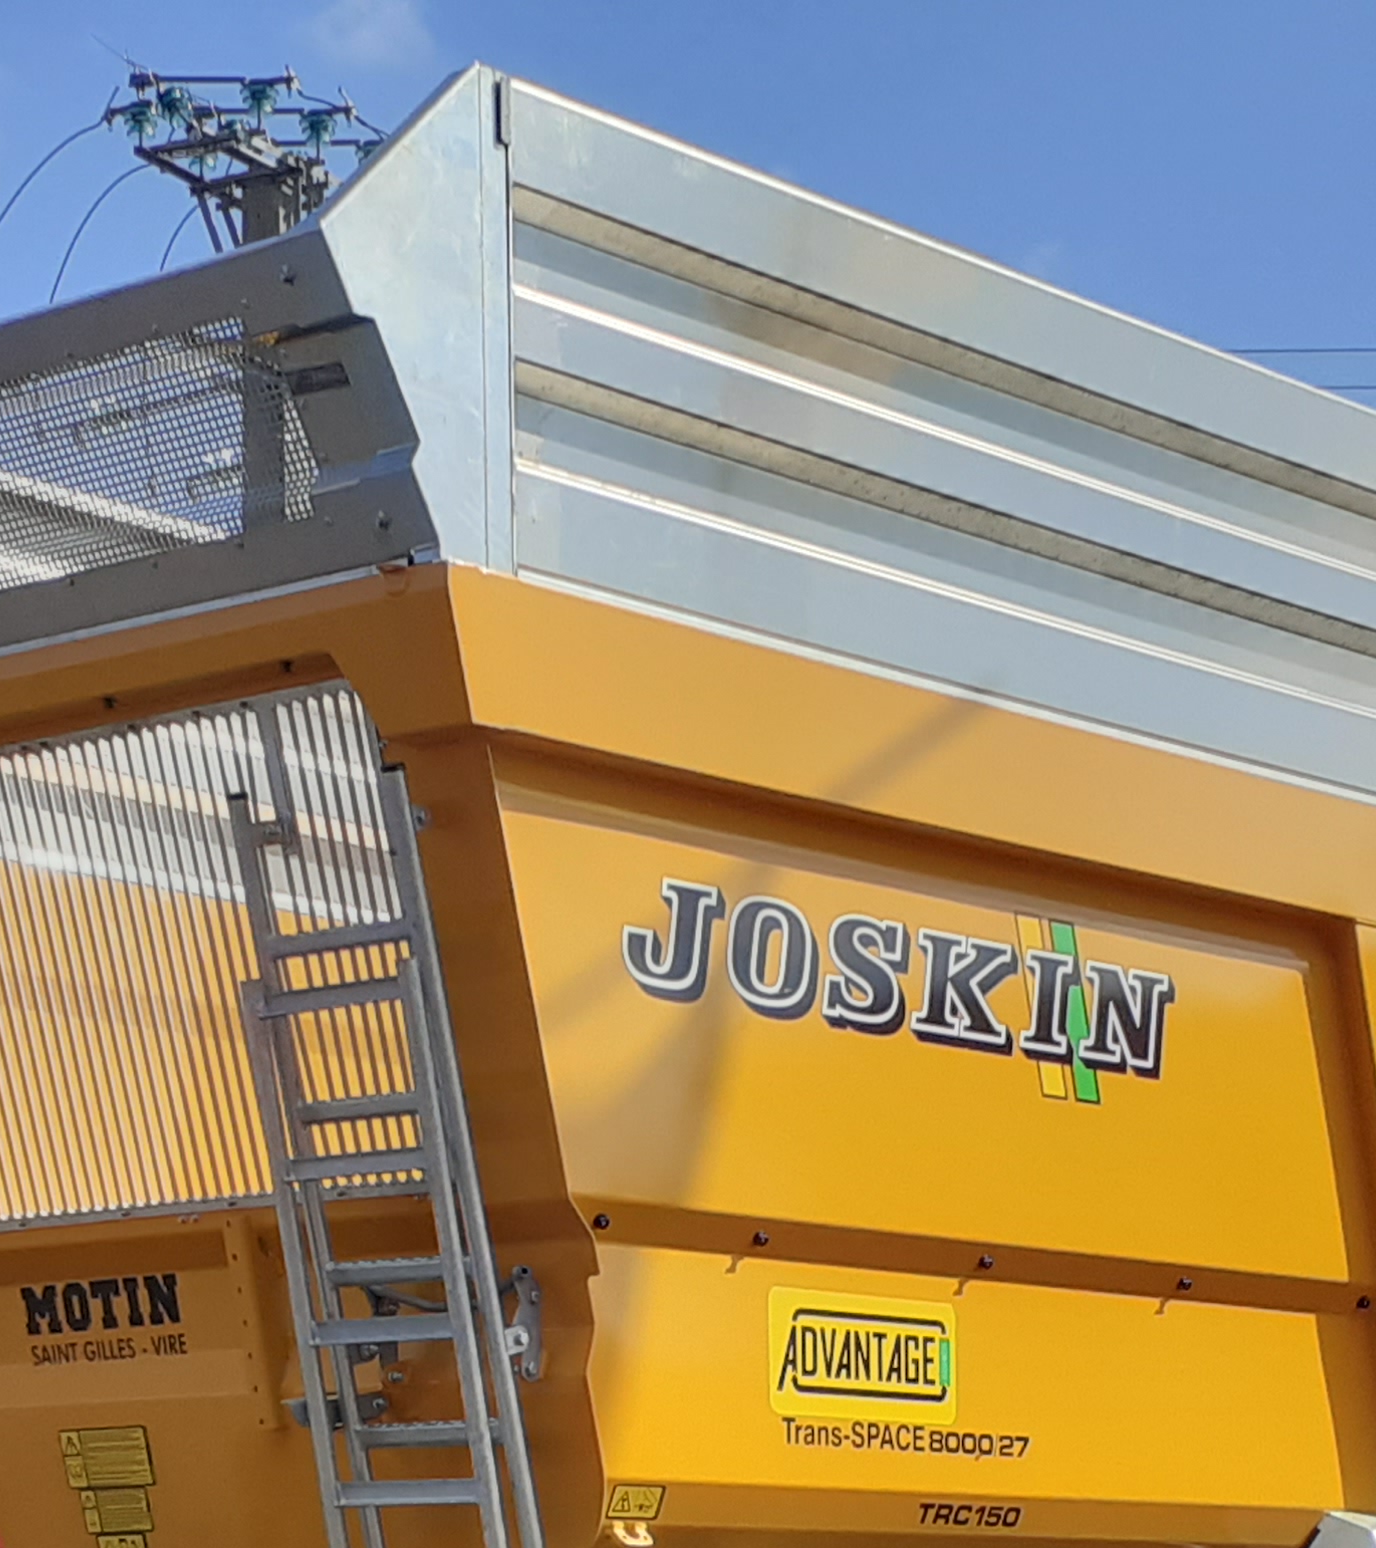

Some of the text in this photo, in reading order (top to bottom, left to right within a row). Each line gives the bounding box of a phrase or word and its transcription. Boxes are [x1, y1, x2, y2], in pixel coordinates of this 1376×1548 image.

[621, 876, 1175, 1079] JOSKIN
[20, 1273, 181, 1335] MOTIN
[31, 1342, 78, 1366] SAINT
[83, 1338, 137, 1363] GILLES
[150, 1333, 188, 1356] VIRE
[777, 1324, 937, 1392] ADVANTAGE
[782, 1417, 926, 1452] Trans-SPACE
[919, 1503, 1021, 1527] TRC150
